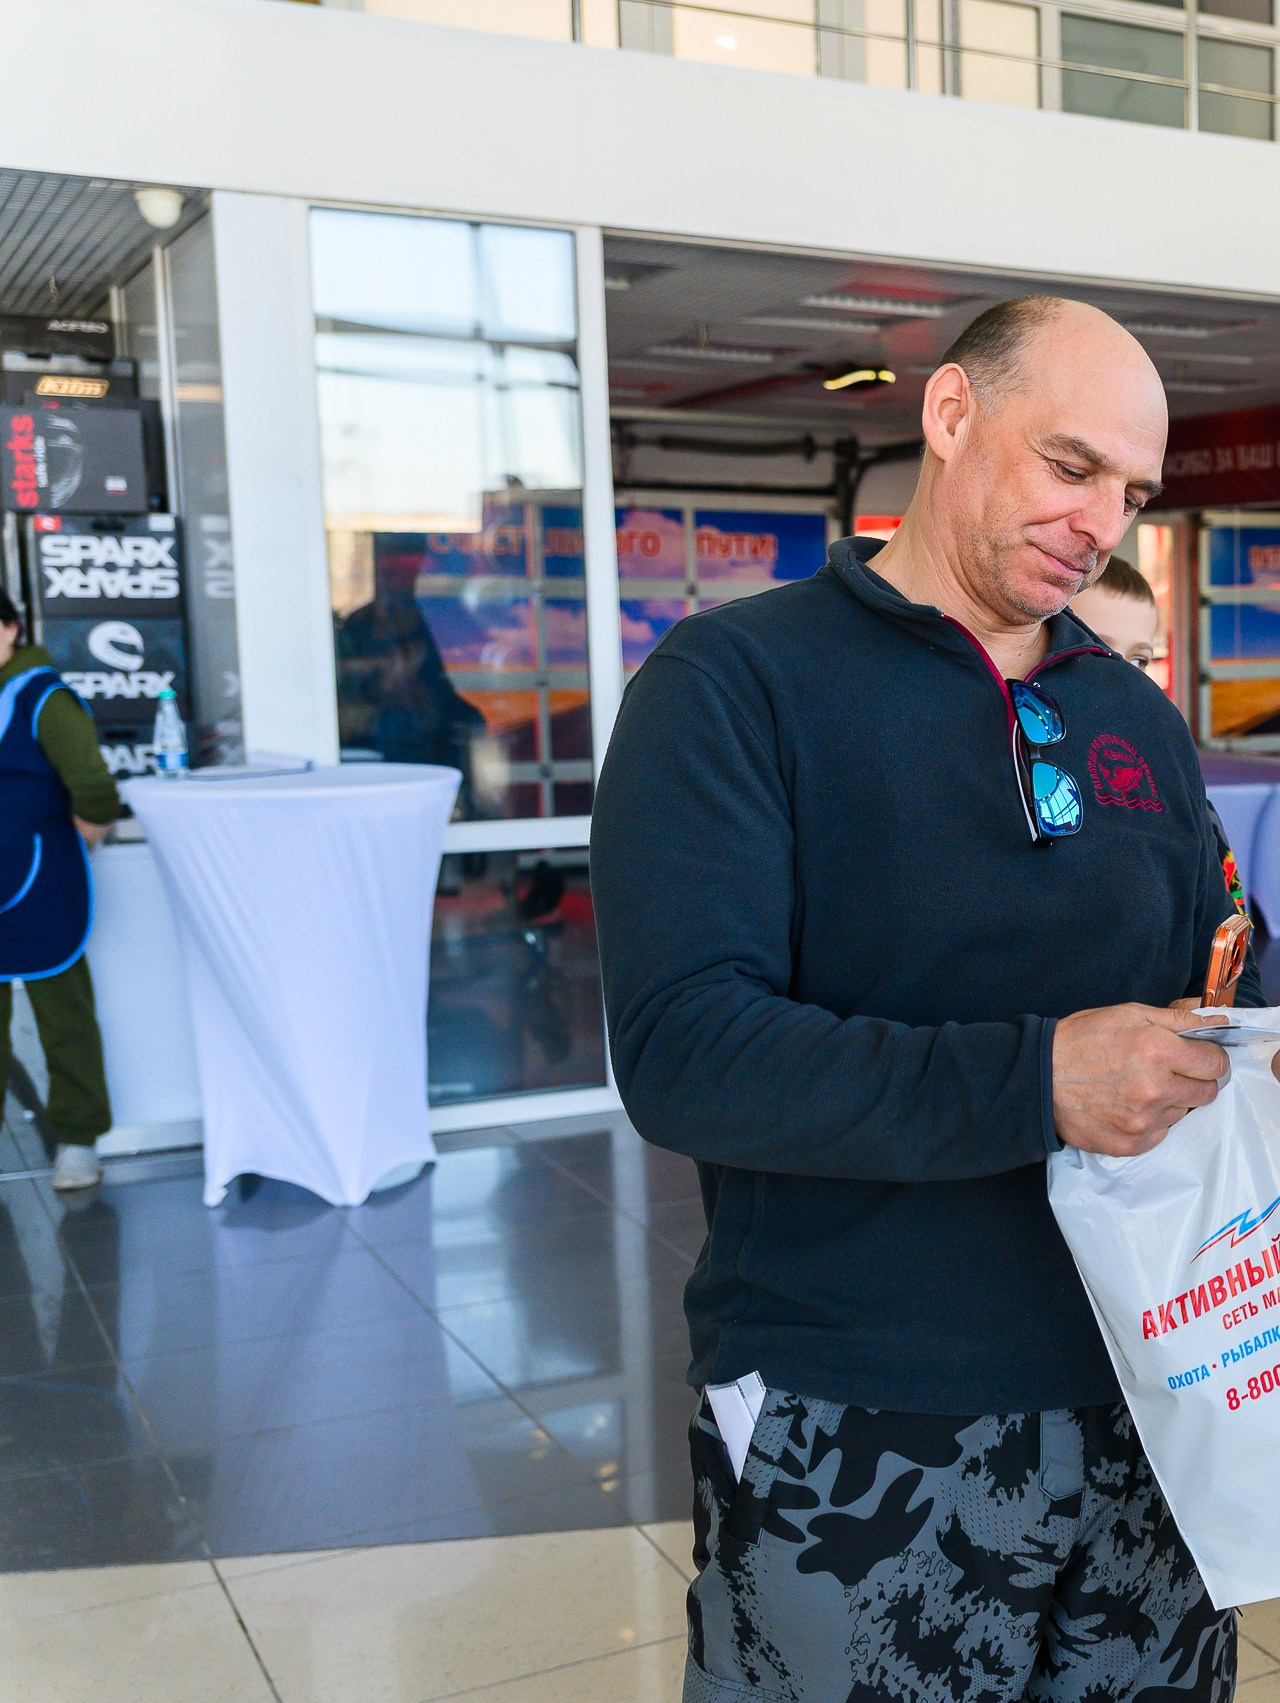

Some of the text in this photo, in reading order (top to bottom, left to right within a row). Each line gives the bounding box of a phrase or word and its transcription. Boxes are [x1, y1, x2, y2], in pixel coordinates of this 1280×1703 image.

[6, 414, 40, 508] starks
[41, 535, 177, 567] SPARX
[1222, 1301, 1259, 1331] СЕТЬ
[1167, 1364, 1211, 1390] ОХОТА
